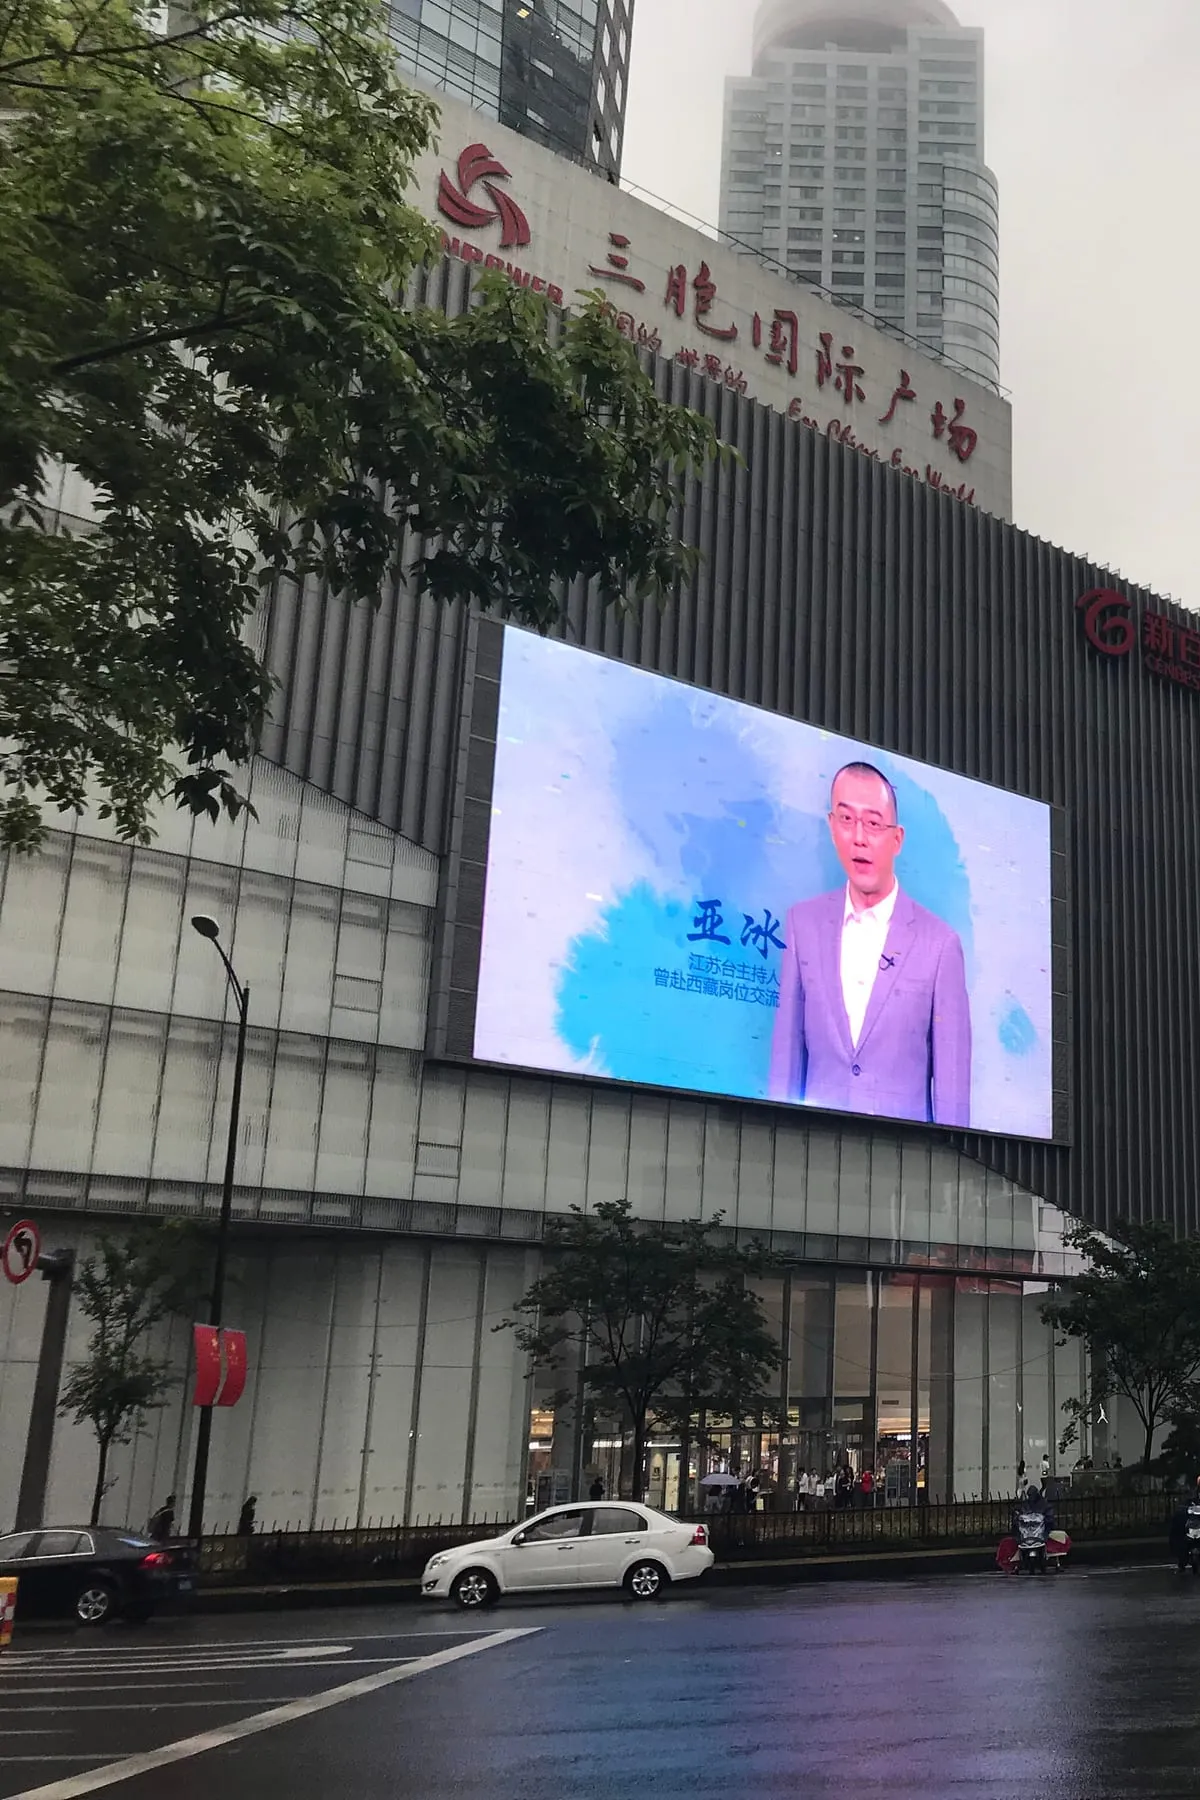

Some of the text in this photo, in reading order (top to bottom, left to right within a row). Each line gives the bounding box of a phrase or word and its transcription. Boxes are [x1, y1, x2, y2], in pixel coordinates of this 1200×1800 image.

[588, 232, 978, 462] 三胞国际广场
[686, 899, 788, 960] 亚冰
[654, 967, 781, 1008] 曾赴西藏岗位交流
[688, 952, 781, 987] 江苏台主持人
